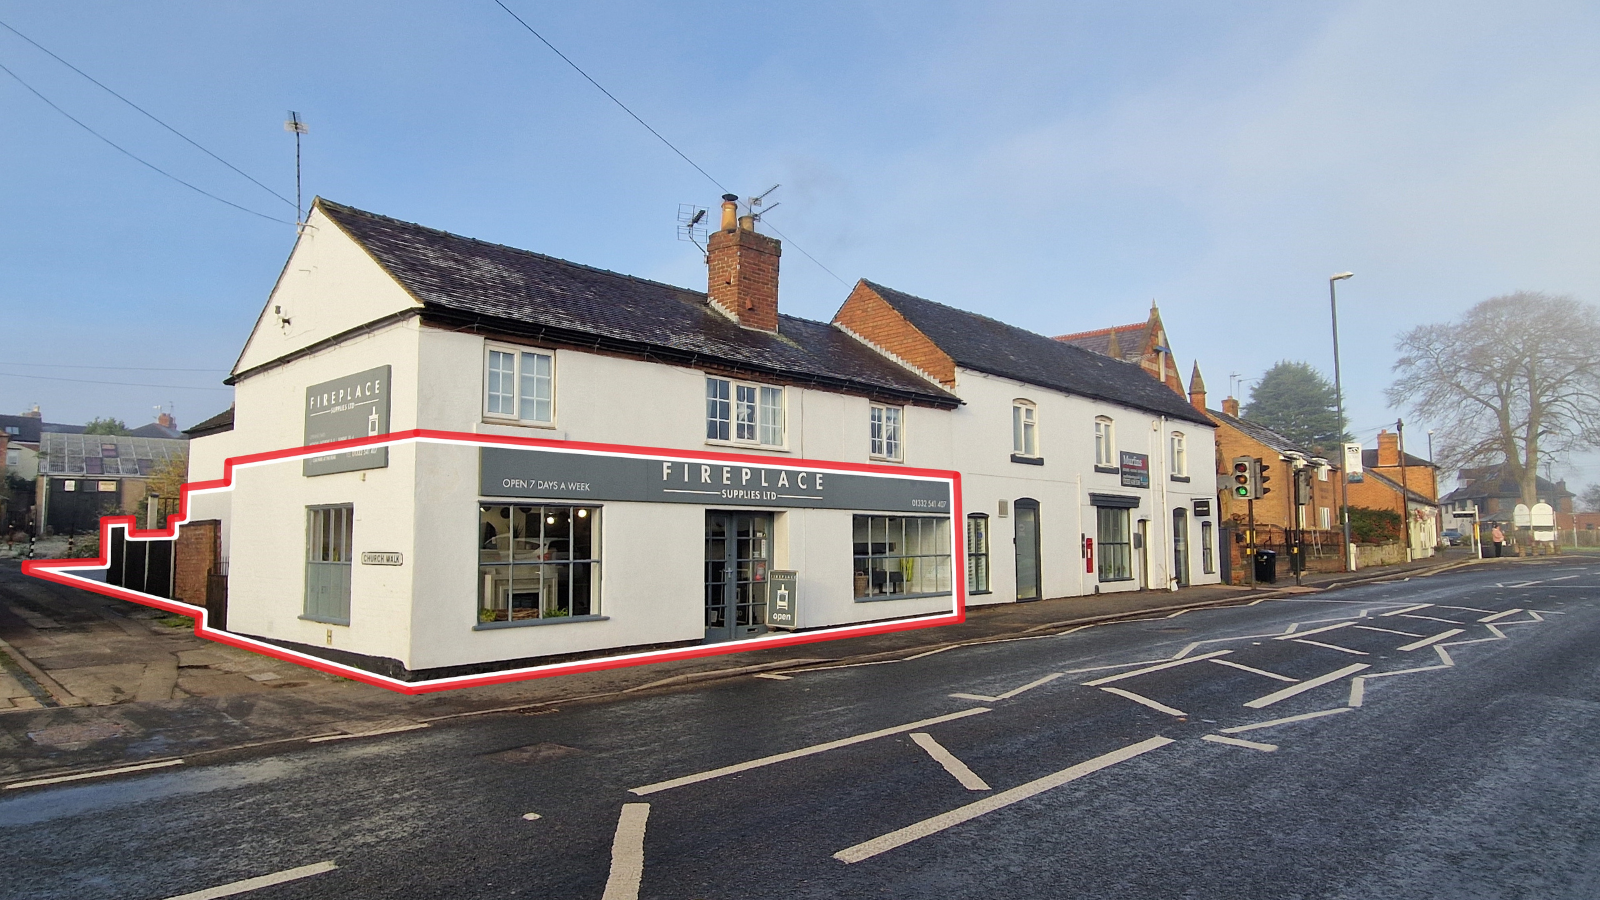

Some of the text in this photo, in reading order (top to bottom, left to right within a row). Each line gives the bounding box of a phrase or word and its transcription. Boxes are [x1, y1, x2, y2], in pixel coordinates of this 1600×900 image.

[310, 380, 380, 409] FIREPLACE
[330, 405, 348, 414] SUPPLIES
[662, 461, 824, 490] FIREPLACE
[502, 478, 590, 491] OPEN 7 DAYS A WEEK
[721, 489, 777, 500] SUPPLIES LTD
[911, 499, 927, 507] 01332
[364, 554, 399, 563] CHURCH WALK
[773, 613, 791, 621] open
